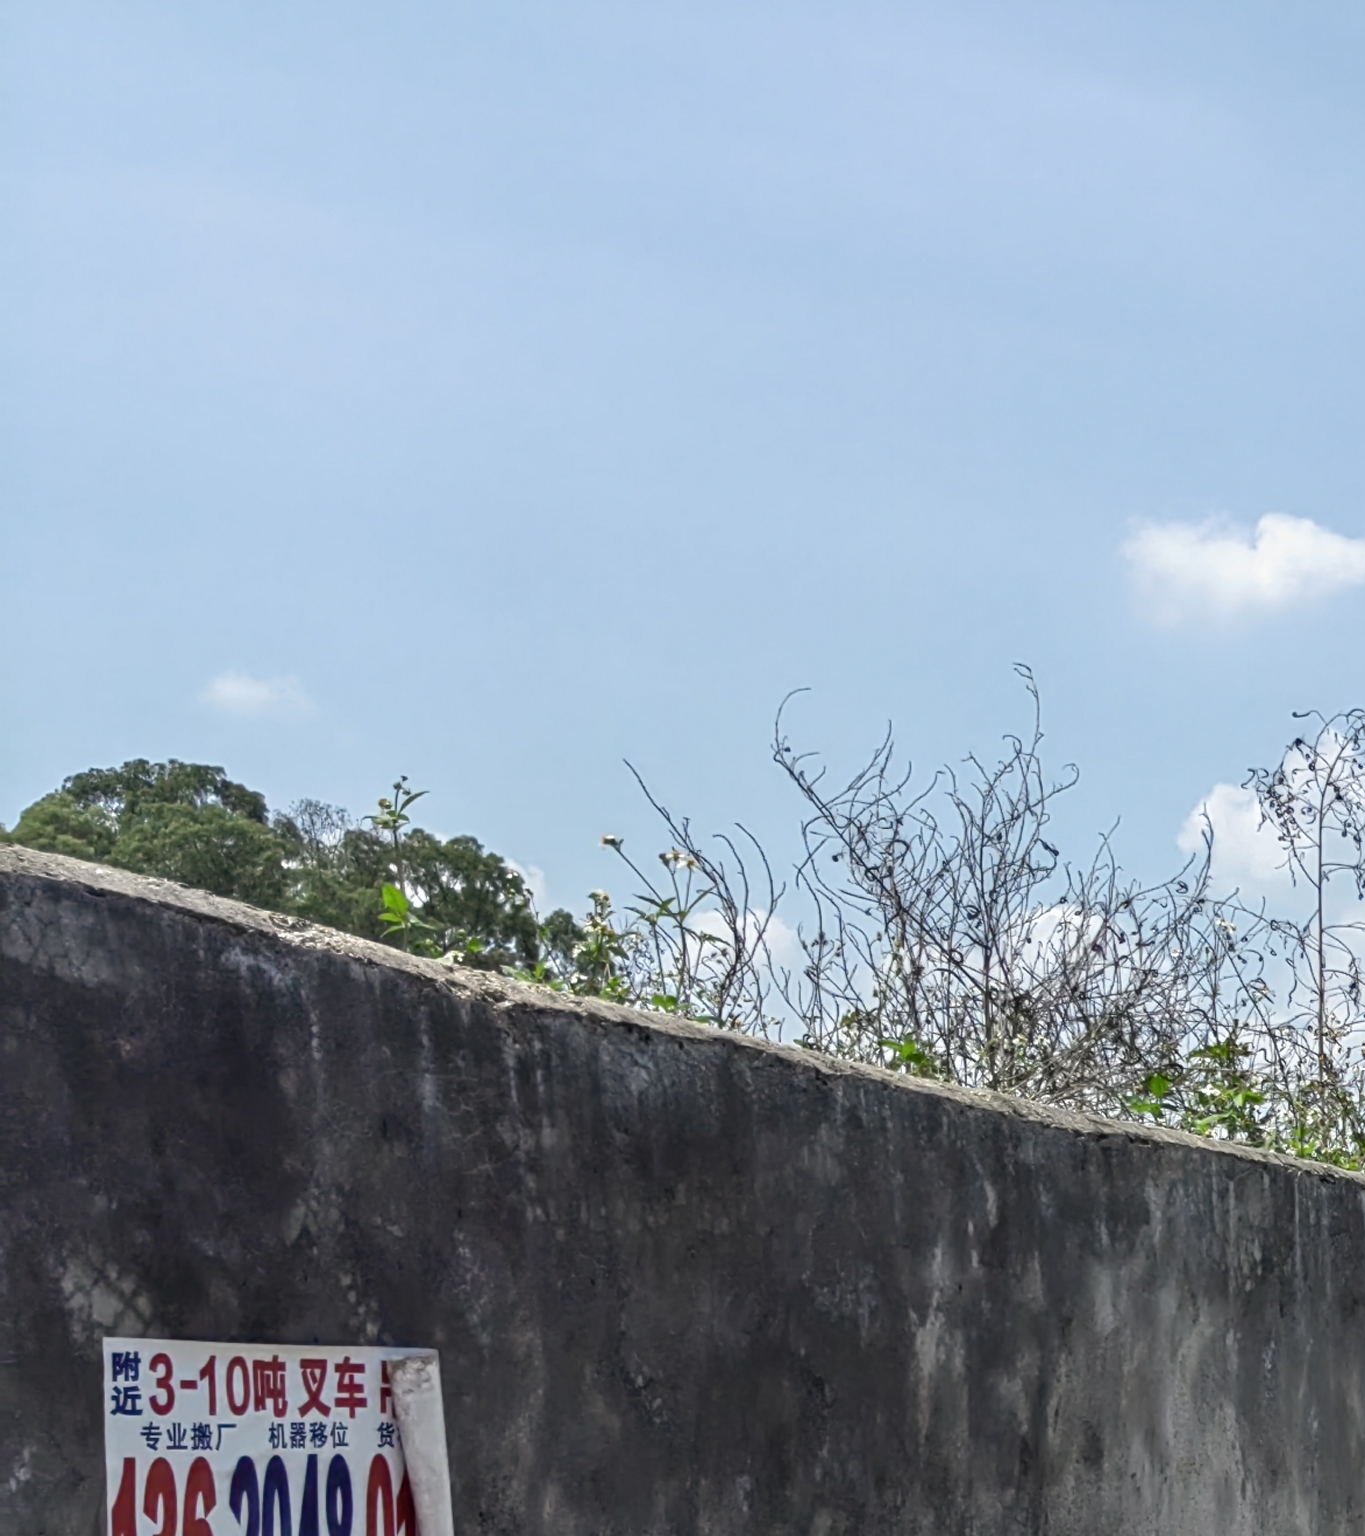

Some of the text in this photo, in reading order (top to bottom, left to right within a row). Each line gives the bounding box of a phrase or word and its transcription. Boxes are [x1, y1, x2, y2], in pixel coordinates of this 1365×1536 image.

[111, 1351, 143, 1416] 附近
[140, 1421, 402, 1451] 专业搬厂 机器移位 货
